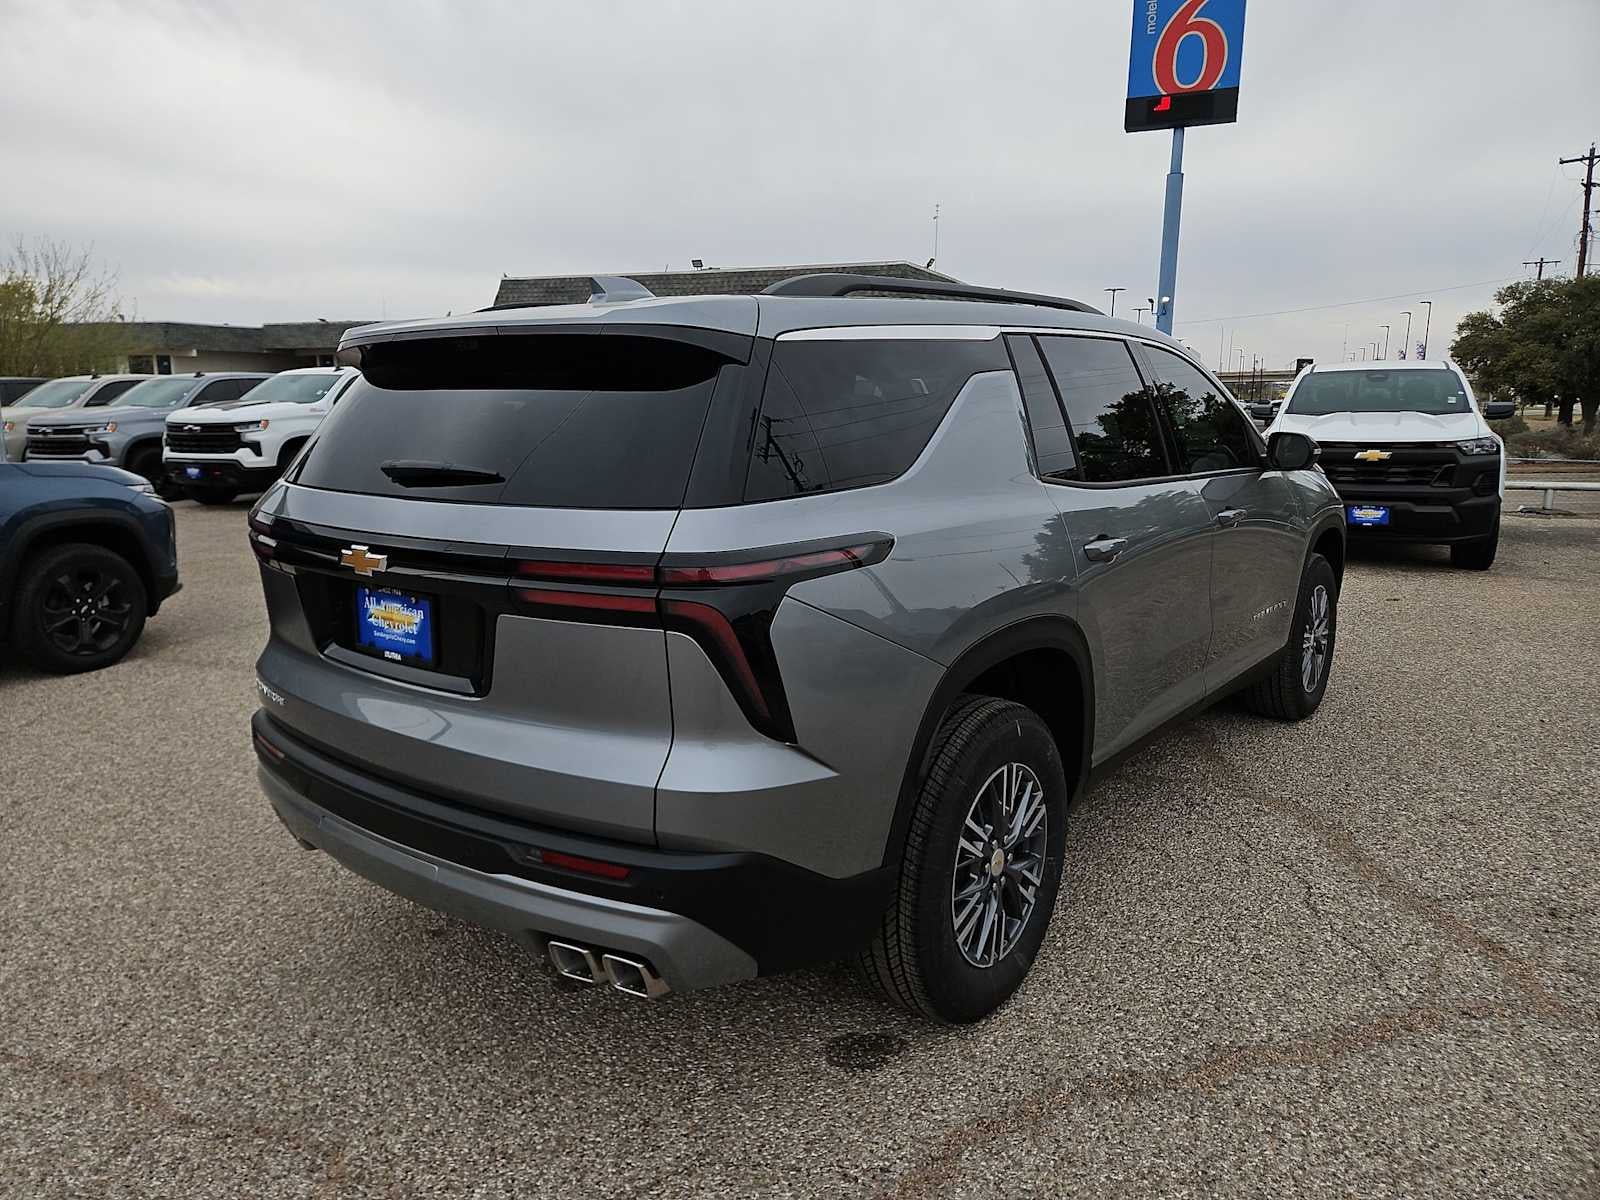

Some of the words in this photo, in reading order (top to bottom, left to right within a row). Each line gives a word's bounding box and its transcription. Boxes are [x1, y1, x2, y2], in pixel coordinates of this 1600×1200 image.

[1146, 0, 1158, 35] motel
[1152, 0, 1229, 94] 6
[364, 596, 376, 609] All
[379, 599, 424, 620] American
[371, 614, 418, 635] Chevrolet
